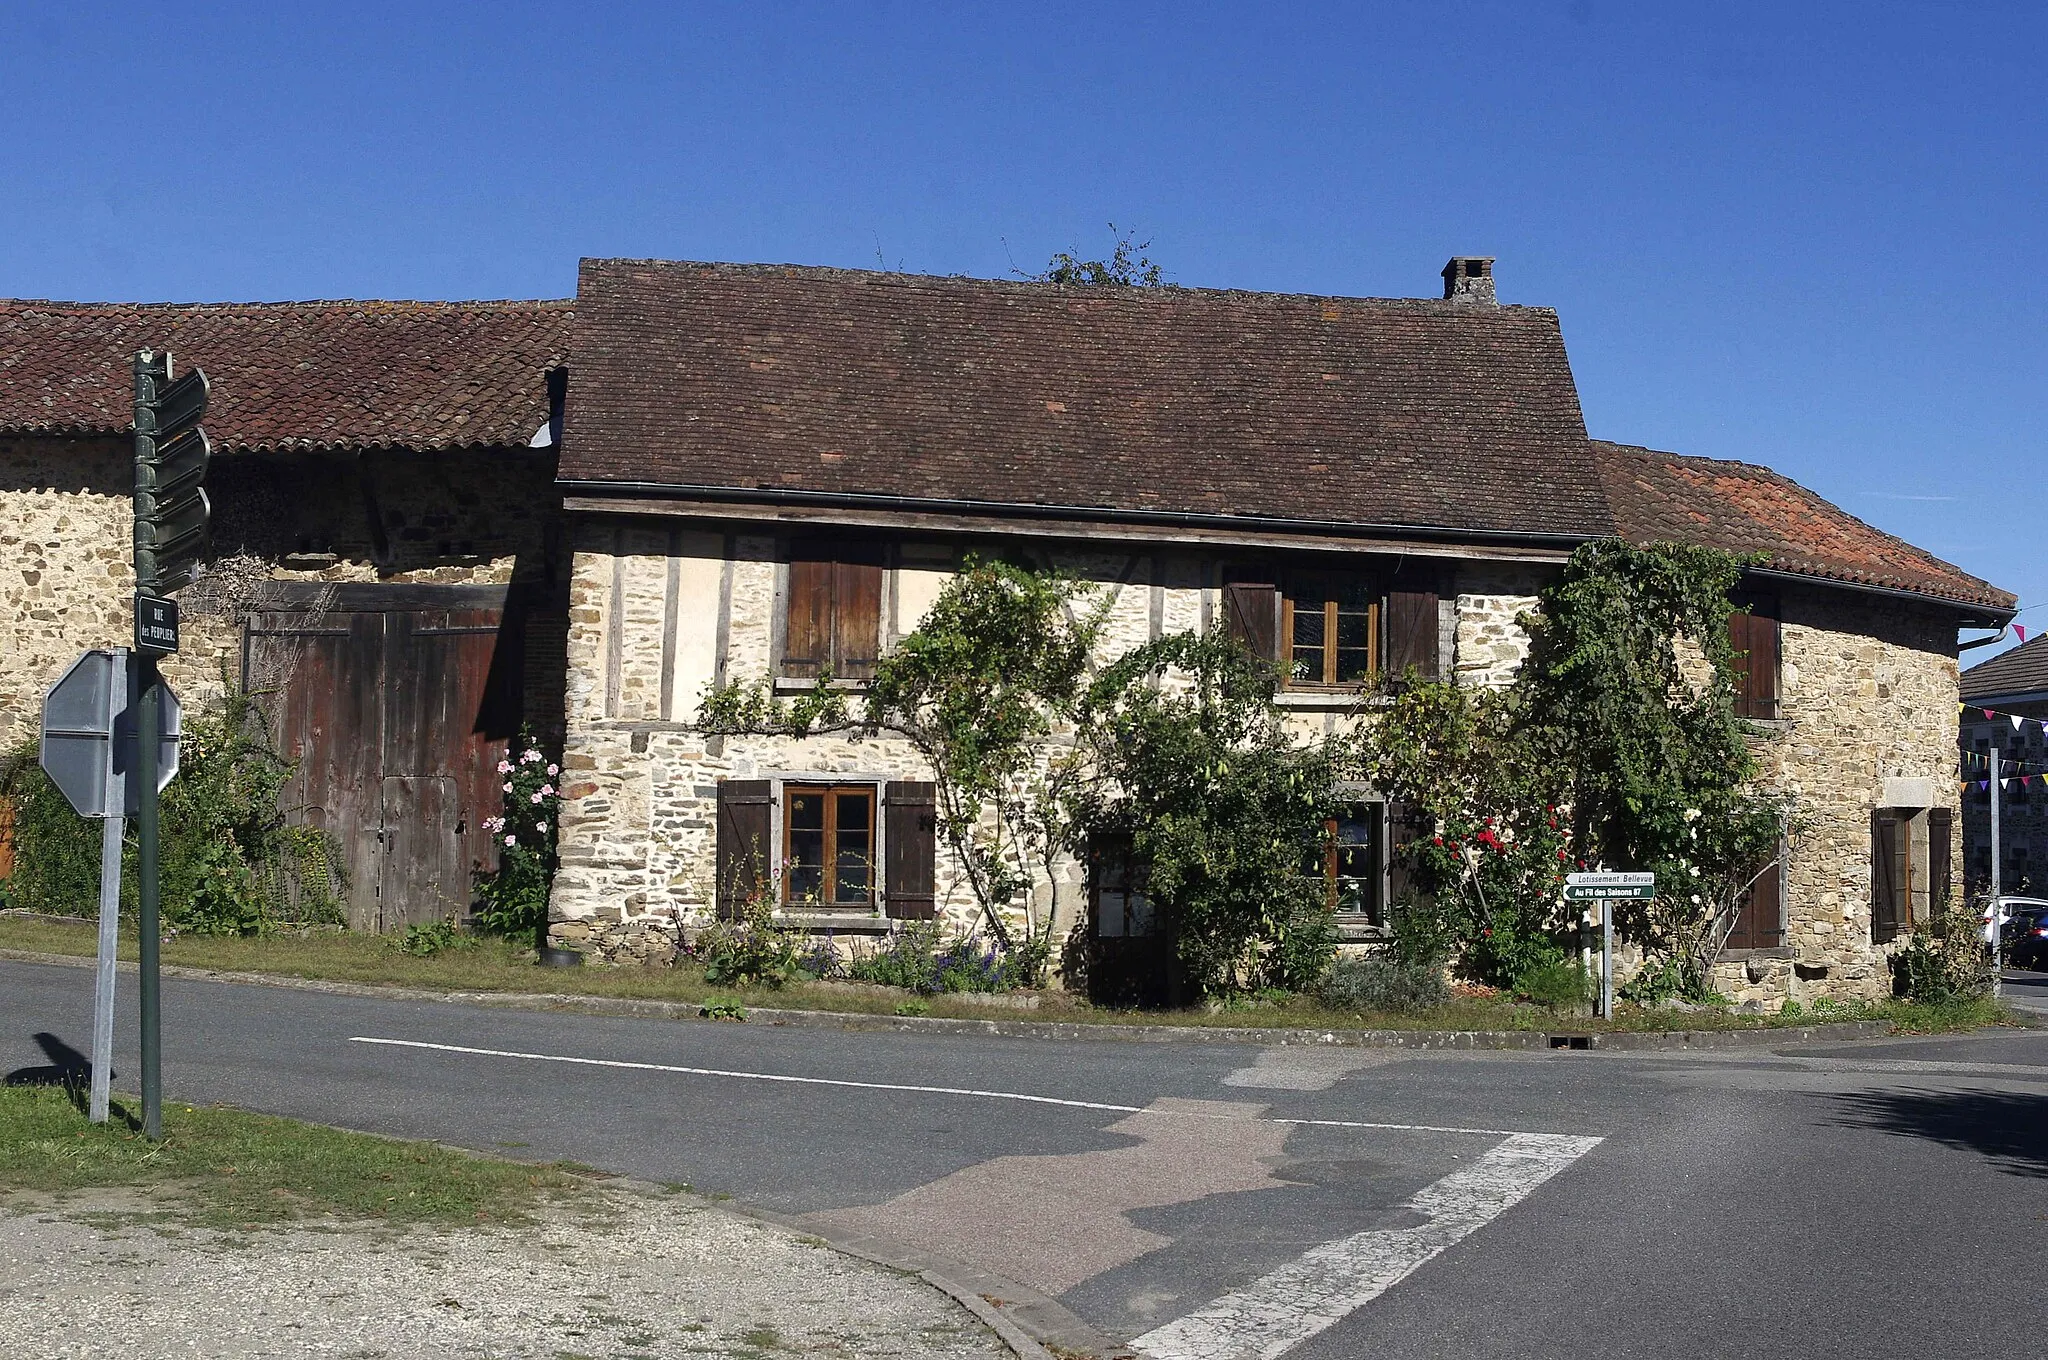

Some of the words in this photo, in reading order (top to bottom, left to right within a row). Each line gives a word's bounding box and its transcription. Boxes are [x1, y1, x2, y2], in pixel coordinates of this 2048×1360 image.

[154, 608, 164, 622] RUE
[142, 624, 150, 637] des
[1578, 875, 1620, 883] Lotissement
[1623, 874, 1653, 883] Bellevue
[1574, 888, 1584, 896] Au
[1585, 888, 1593, 896] Fil
[1594, 888, 1606, 896] des
[1607, 888, 1633, 896] Saisons
[1633, 887, 1641, 896] 87
